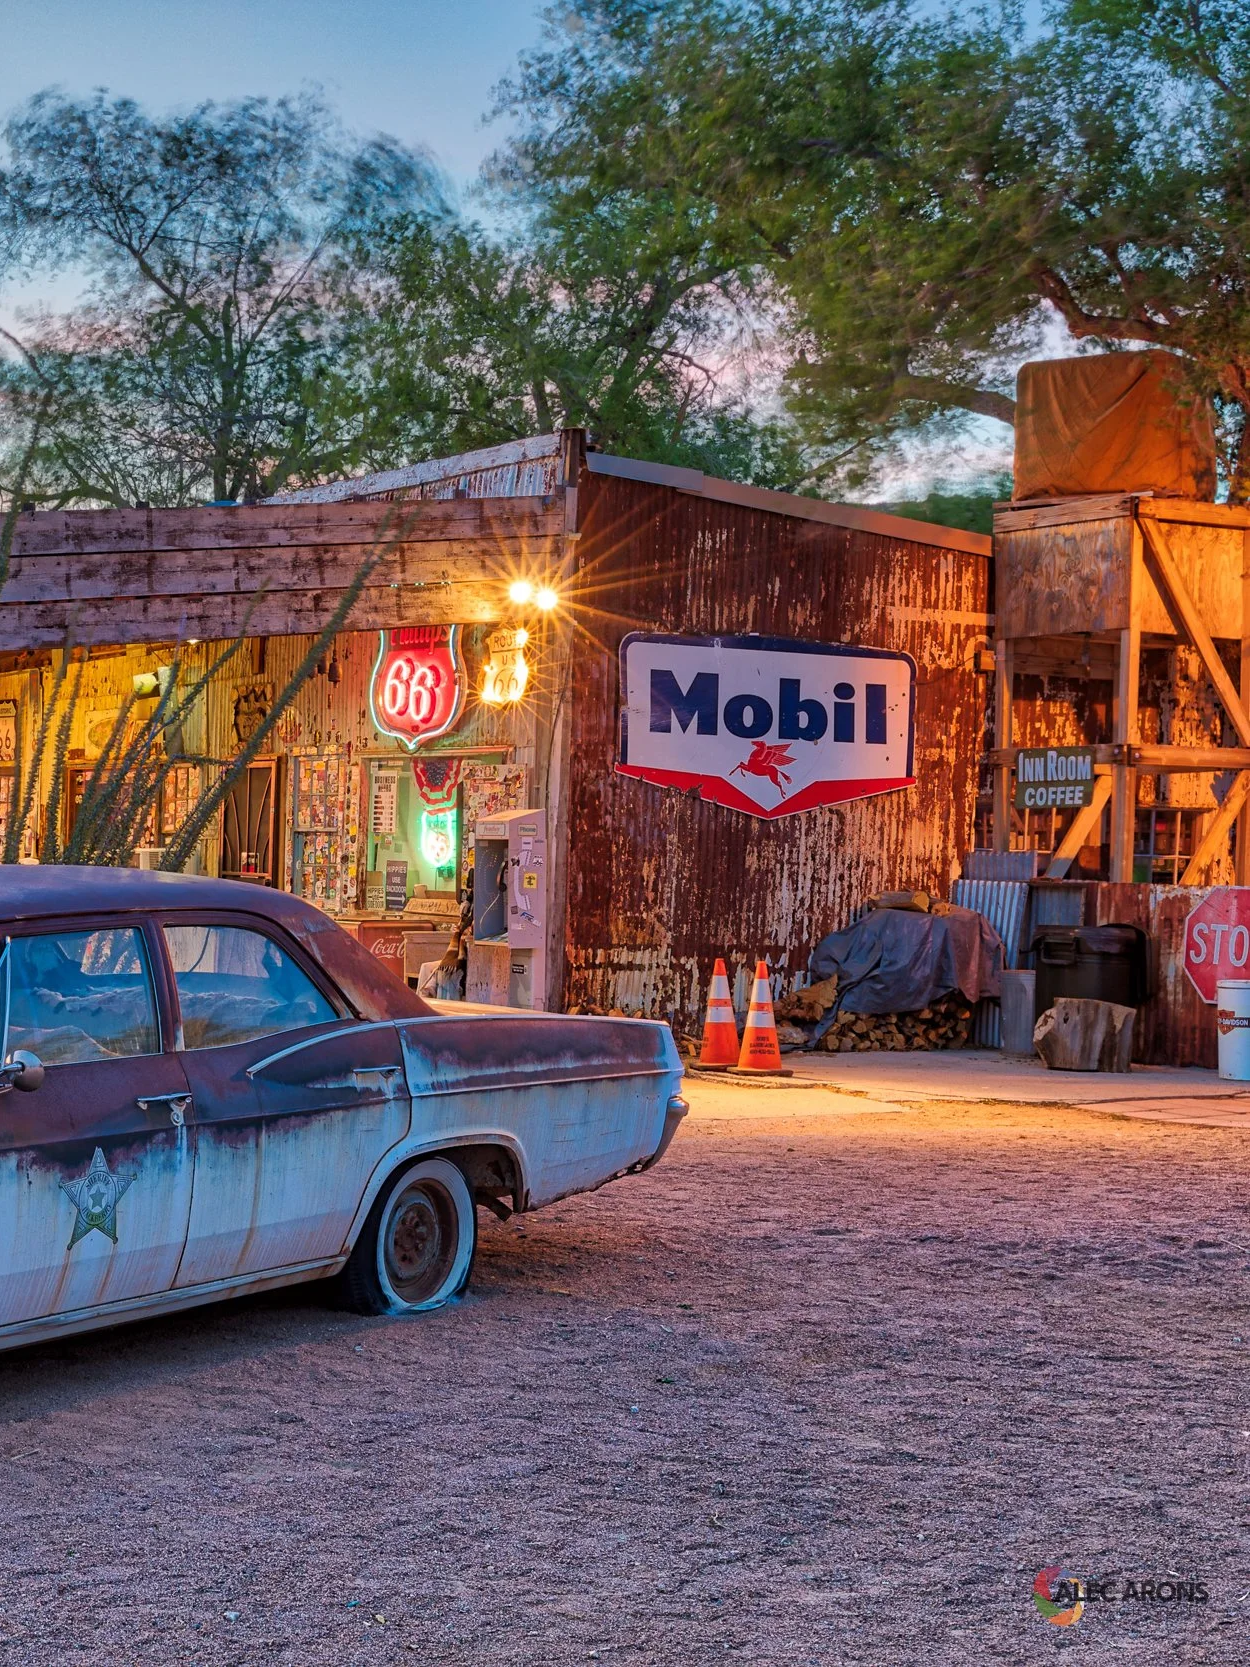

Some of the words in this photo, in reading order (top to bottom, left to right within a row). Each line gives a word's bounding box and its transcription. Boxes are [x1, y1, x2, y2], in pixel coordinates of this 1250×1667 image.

[494, 635, 519, 648] ROUT
[384, 657, 441, 724] 66
[493, 668, 519, 700] 66
[650, 669, 887, 744] Mobil
[374, 776, 396, 784] BUSINESS
[1024, 785, 1084, 806] COFFEE
[387, 865, 406, 874] HIPPIES
[367, 887, 384, 895] HIPPIES
[370, 938, 405, 958] Coca-C
[1190, 922, 1250, 967] STO
